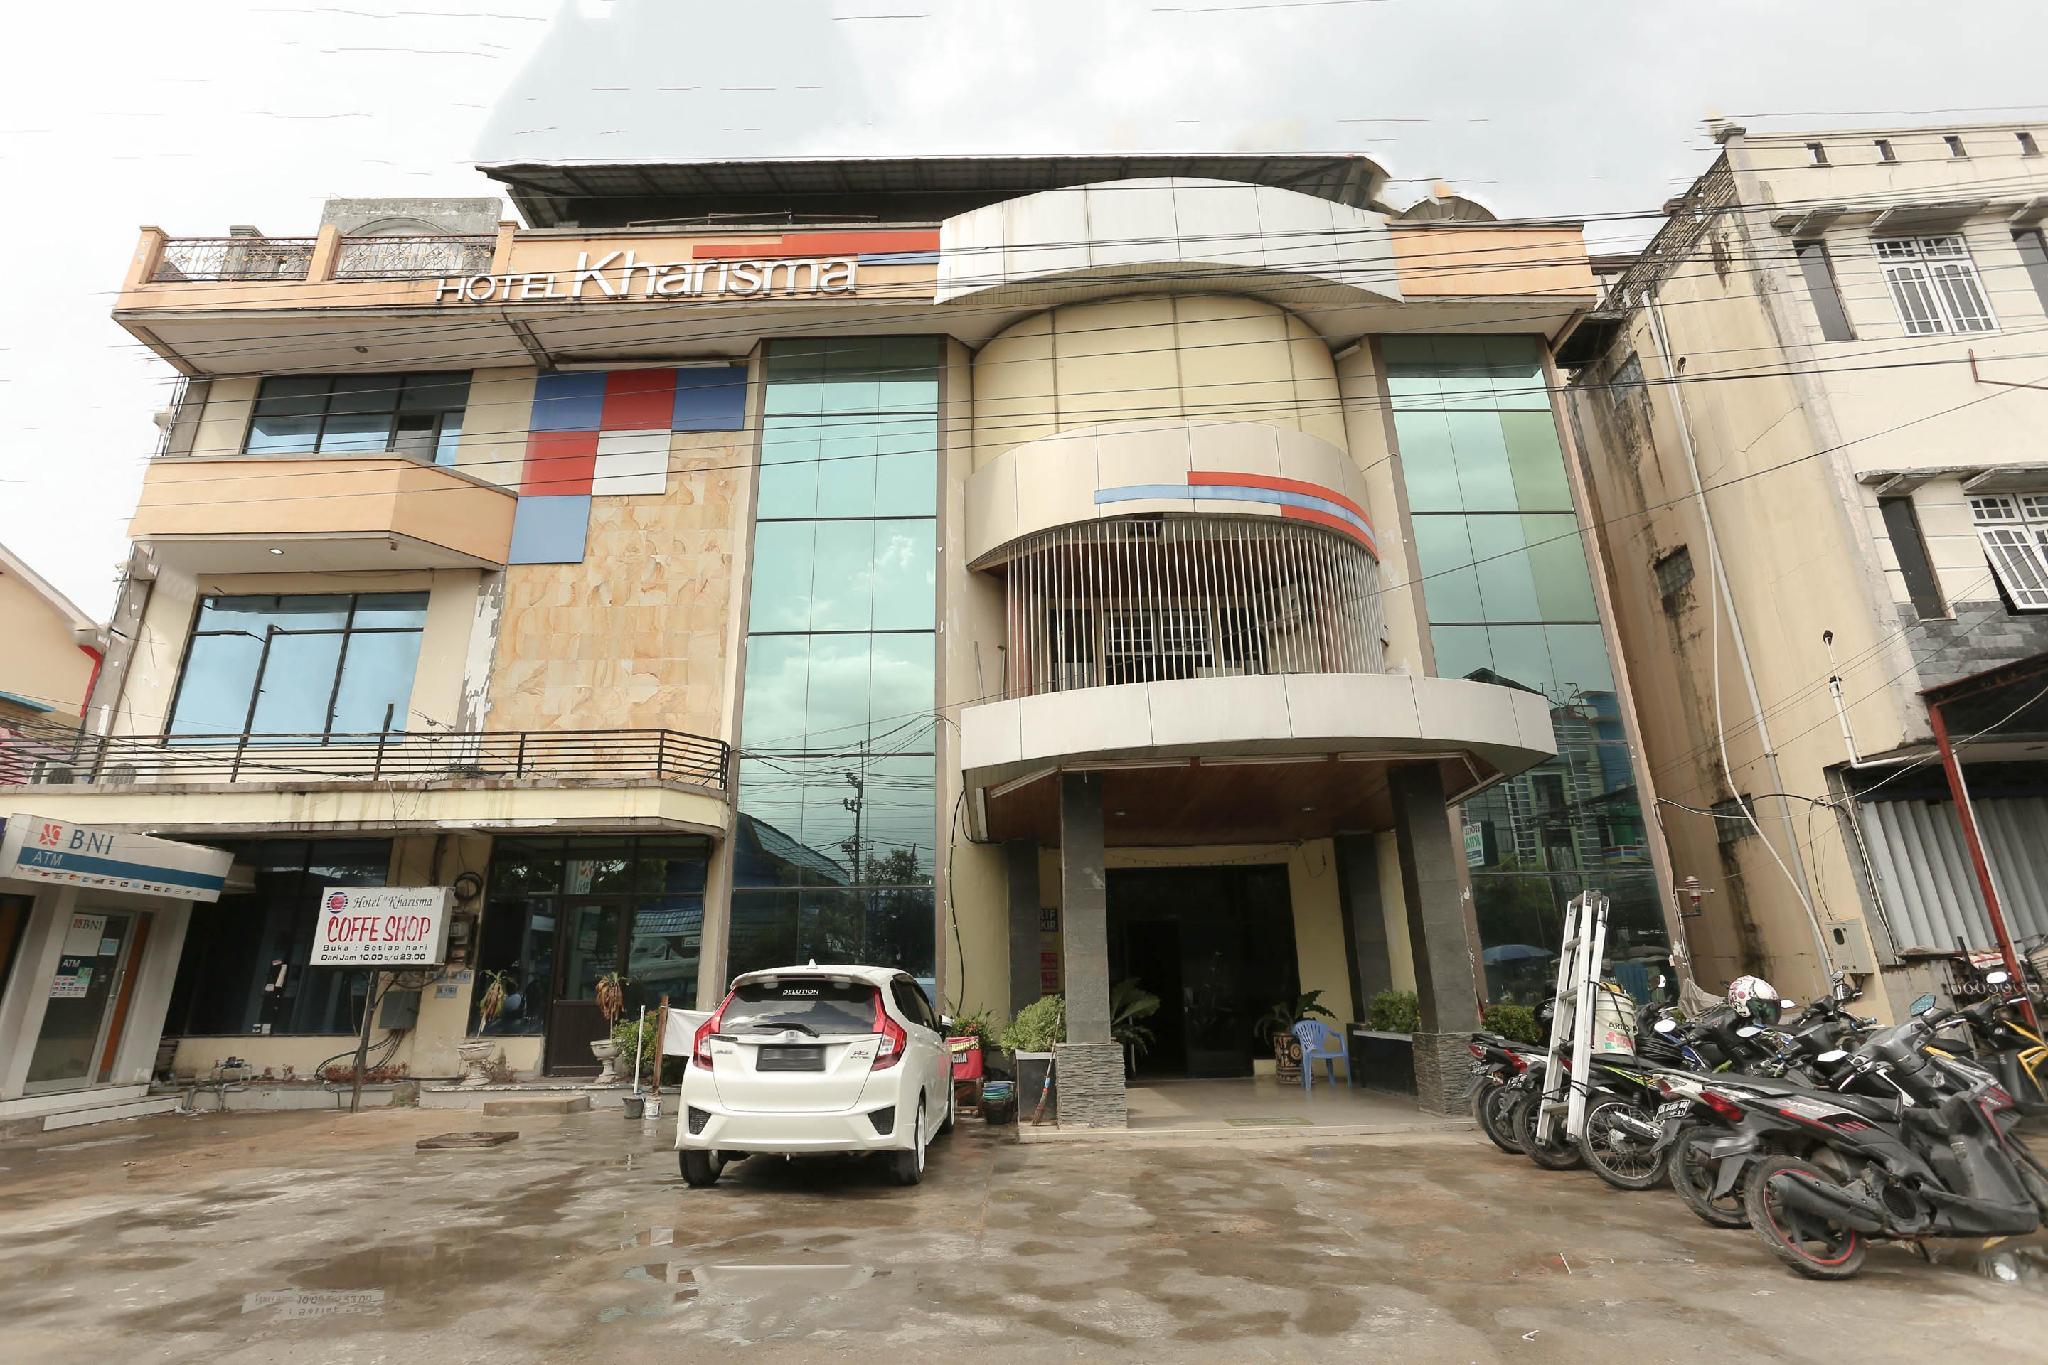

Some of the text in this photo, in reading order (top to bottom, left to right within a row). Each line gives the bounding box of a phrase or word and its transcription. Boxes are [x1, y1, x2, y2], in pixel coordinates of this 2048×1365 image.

[436, 249, 857, 303] HOTEL Kharisma
[69, 829, 114, 855] BNI
[32, 850, 63, 867] ATM
[352, 895, 380, 909] Hotel
[82, 919, 103, 930] BNI
[327, 915, 431, 943] COFFE SHOP
[323, 944, 349, 952] Buka
[405, 944, 428, 952] hari
[62, 959, 81, 968] ATM
